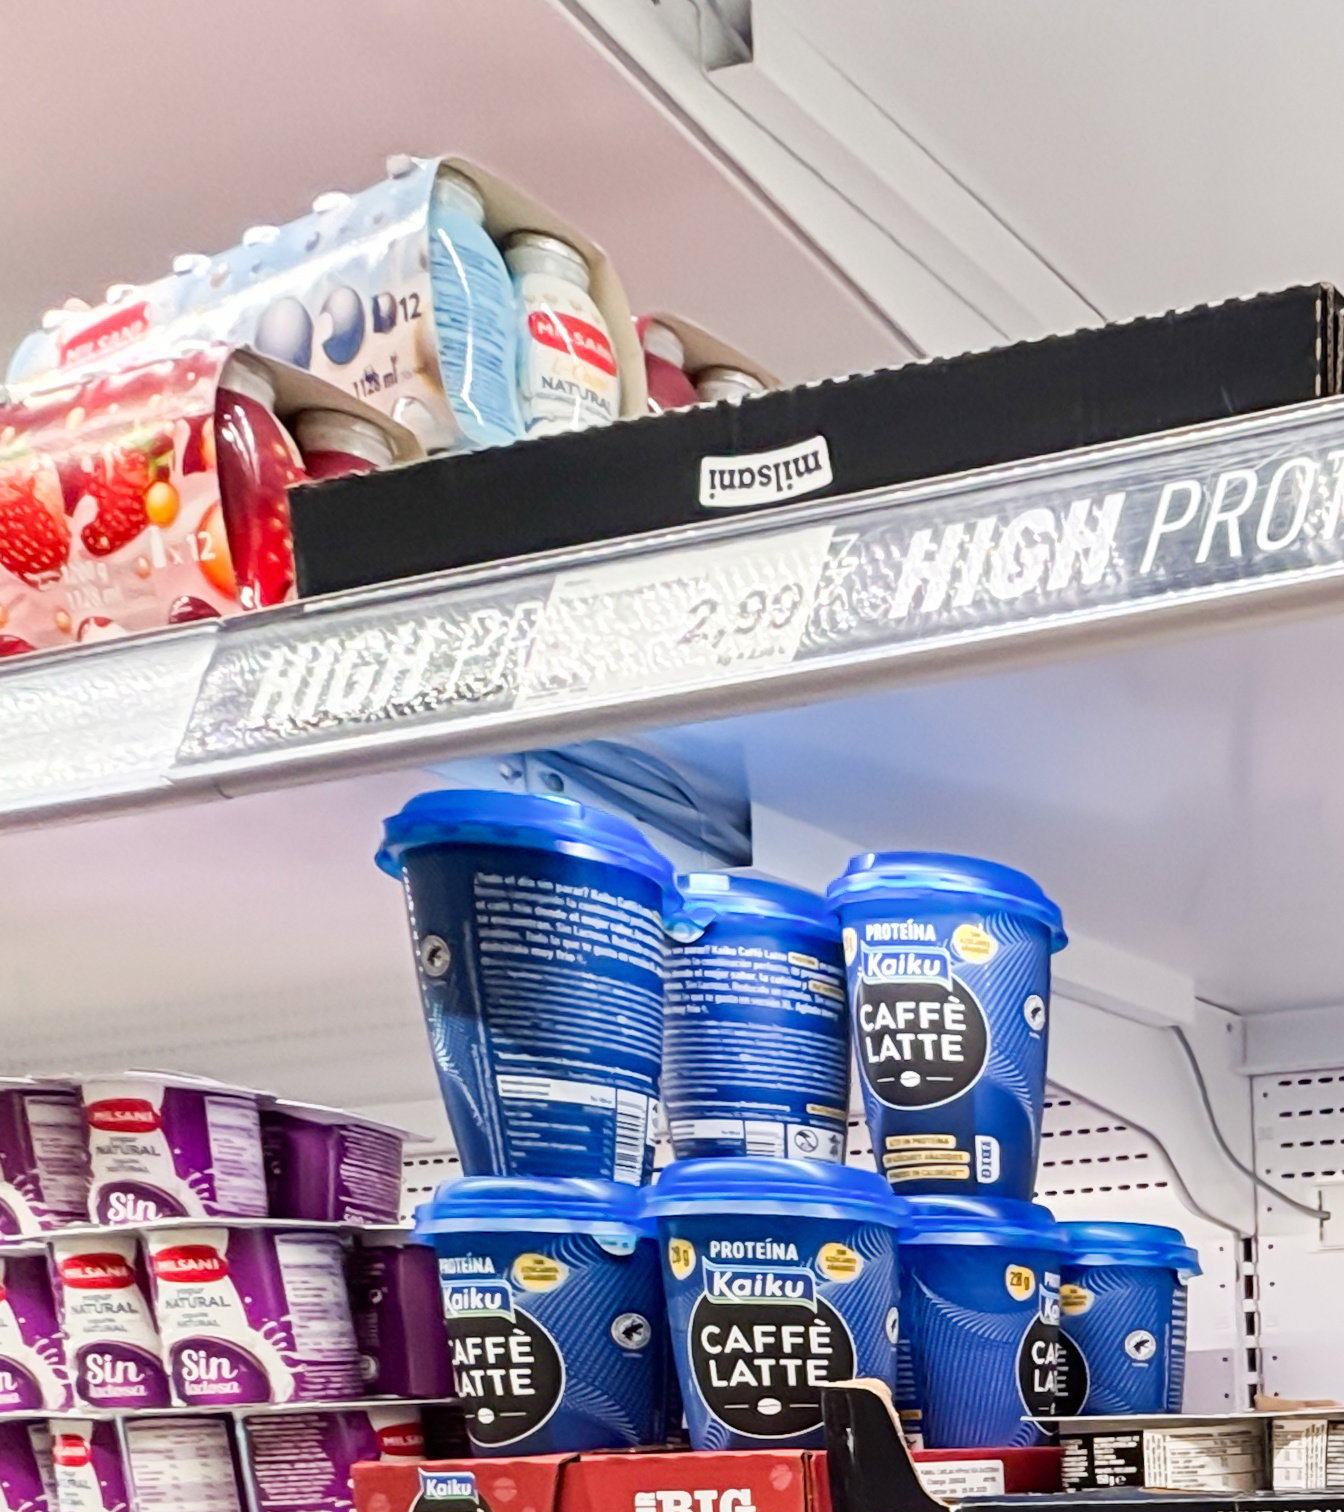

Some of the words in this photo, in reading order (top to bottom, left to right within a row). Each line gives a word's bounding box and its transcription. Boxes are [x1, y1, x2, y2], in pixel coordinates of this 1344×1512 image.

[709, 441, 823, 498] milsani
[890, 494, 1126, 618] HIGH
[866, 919, 936, 941] PROTEÍNA
[868, 953, 941, 979] Kaiku
[860, 996, 966, 1032] CAFFÈ
[866, 1034, 964, 1063] LATTE
[711, 1238, 798, 1261] PROTEÍNA
[713, 1270, 804, 1301] Kaiku
[701, 1318, 832, 1356] CAFFÈ
[181, 1349, 239, 1382] Sin
[709, 1358, 829, 1388] LATTE
[424, 1478, 473, 1496] Kaiku
